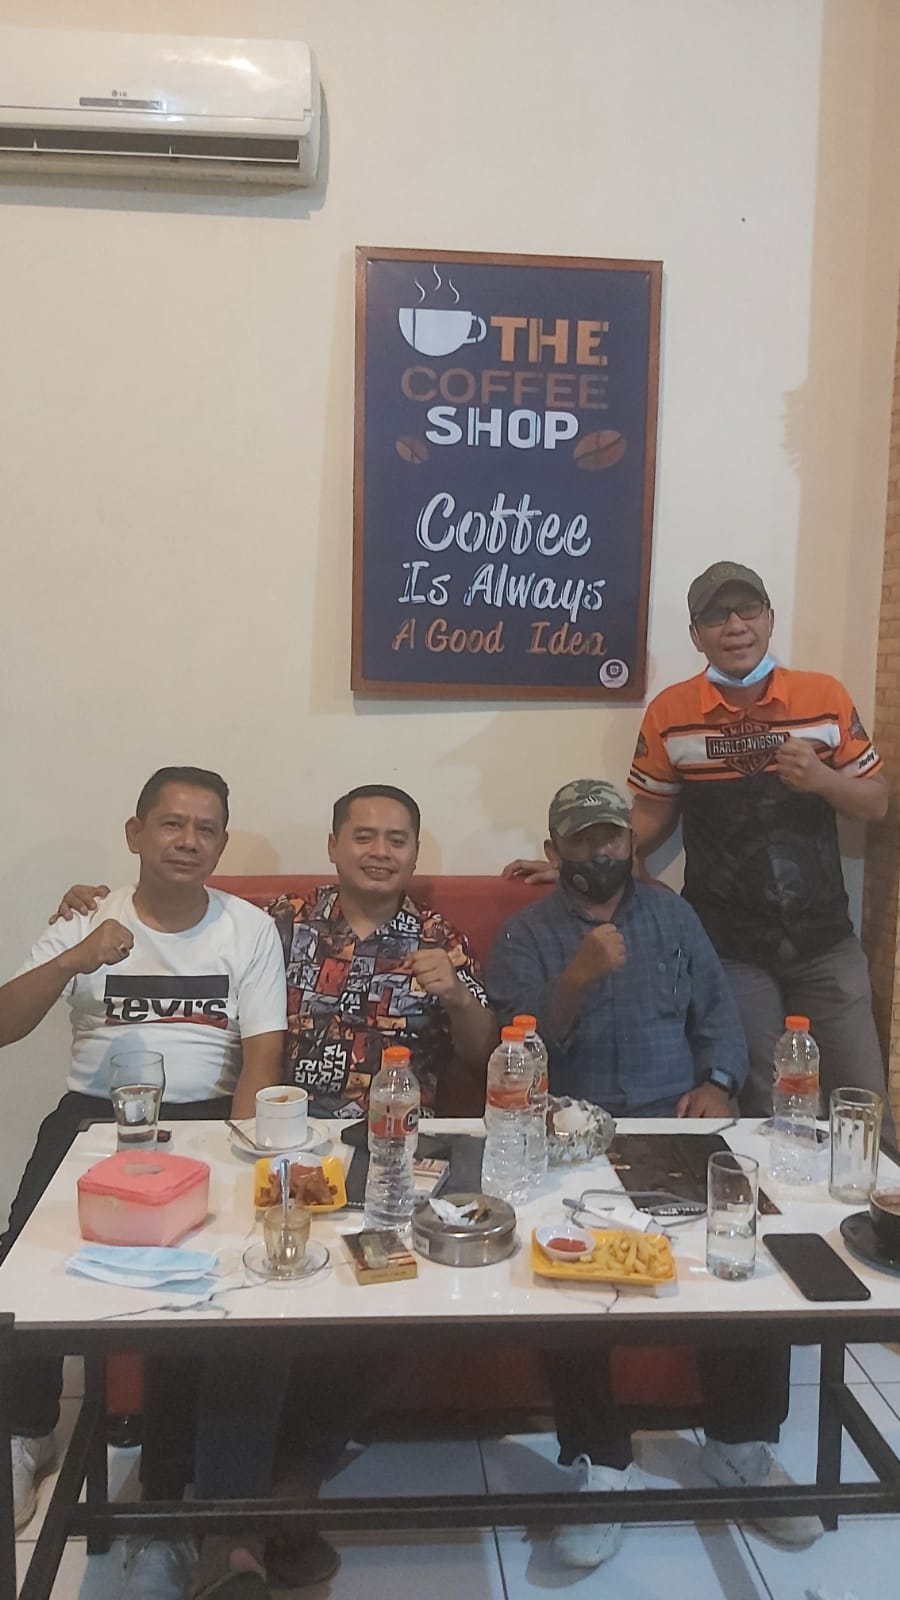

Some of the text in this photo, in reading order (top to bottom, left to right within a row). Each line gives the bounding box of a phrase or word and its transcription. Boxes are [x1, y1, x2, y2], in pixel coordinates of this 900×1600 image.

[490, 316, 610, 367] THE
[401, 366, 609, 410] COFFEE
[425, 406, 579, 450] SHOP
[415, 492, 592, 556] Coffee
[398, 561, 606, 623] Is Always
[391, 618, 607, 657] A Good Idea
